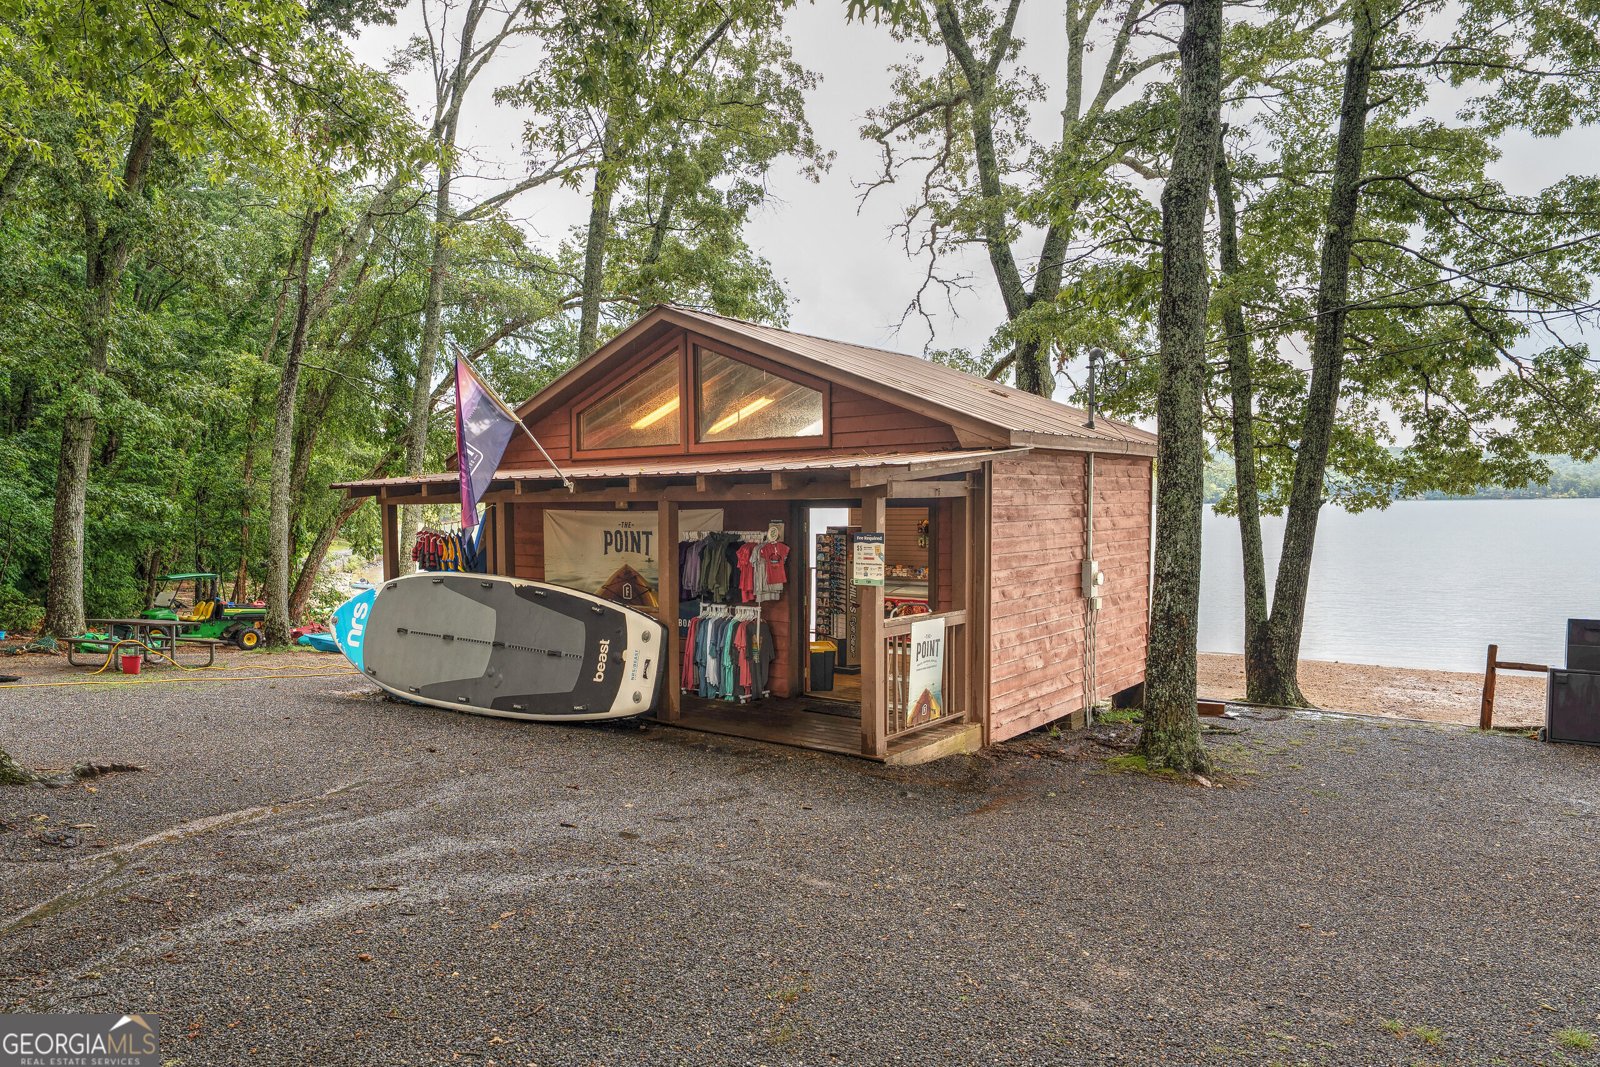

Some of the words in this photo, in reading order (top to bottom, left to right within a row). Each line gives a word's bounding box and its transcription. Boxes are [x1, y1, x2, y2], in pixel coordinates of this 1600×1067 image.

[603, 529, 653, 556] POINT
[593, 639, 610, 682] beast
[915, 638, 941, 663] POINT
